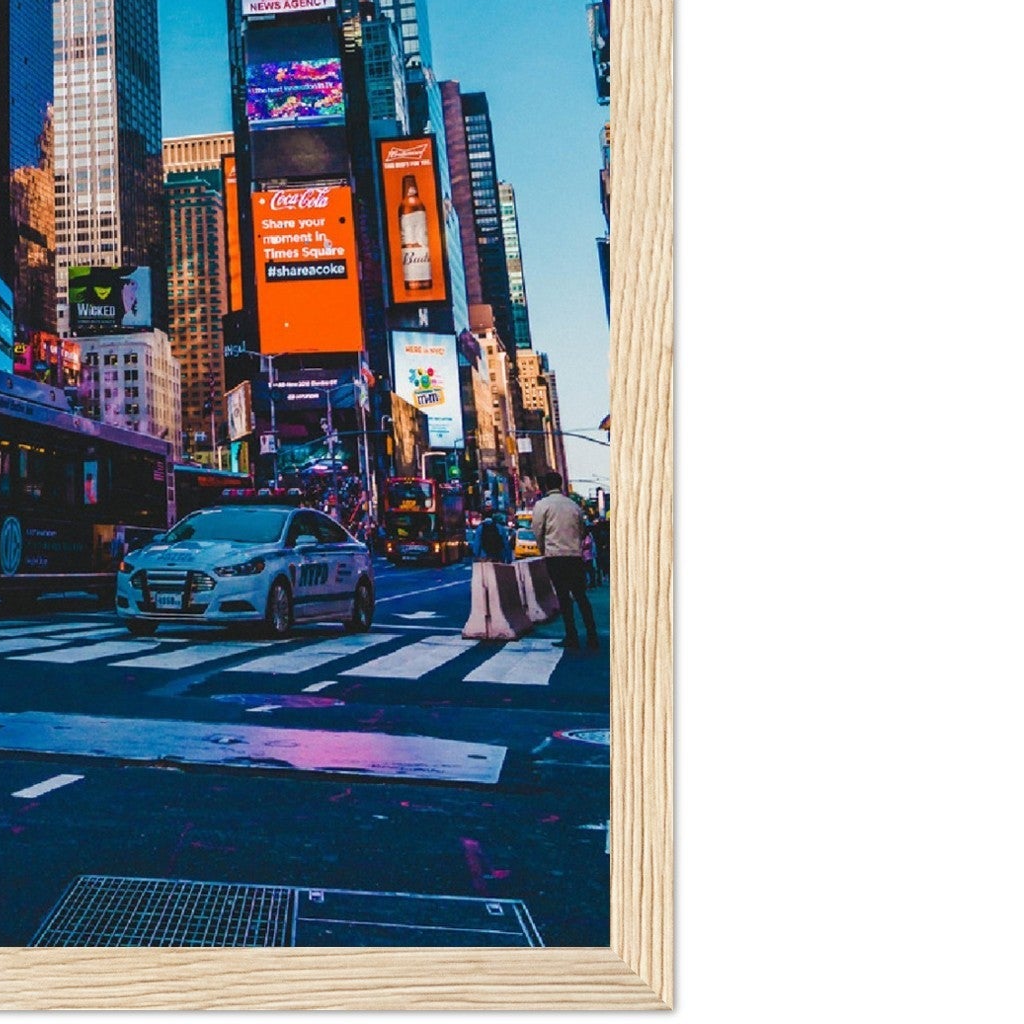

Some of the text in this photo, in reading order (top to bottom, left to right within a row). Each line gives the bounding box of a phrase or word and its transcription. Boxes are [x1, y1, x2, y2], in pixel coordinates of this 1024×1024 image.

[250, 1, 281, 12] NEWS
[262, 217, 325, 229] Share your
[263, 231, 327, 244] moment in
[264, 246, 345, 259] Times Square
[267, 262, 345, 277] #shareacoke
